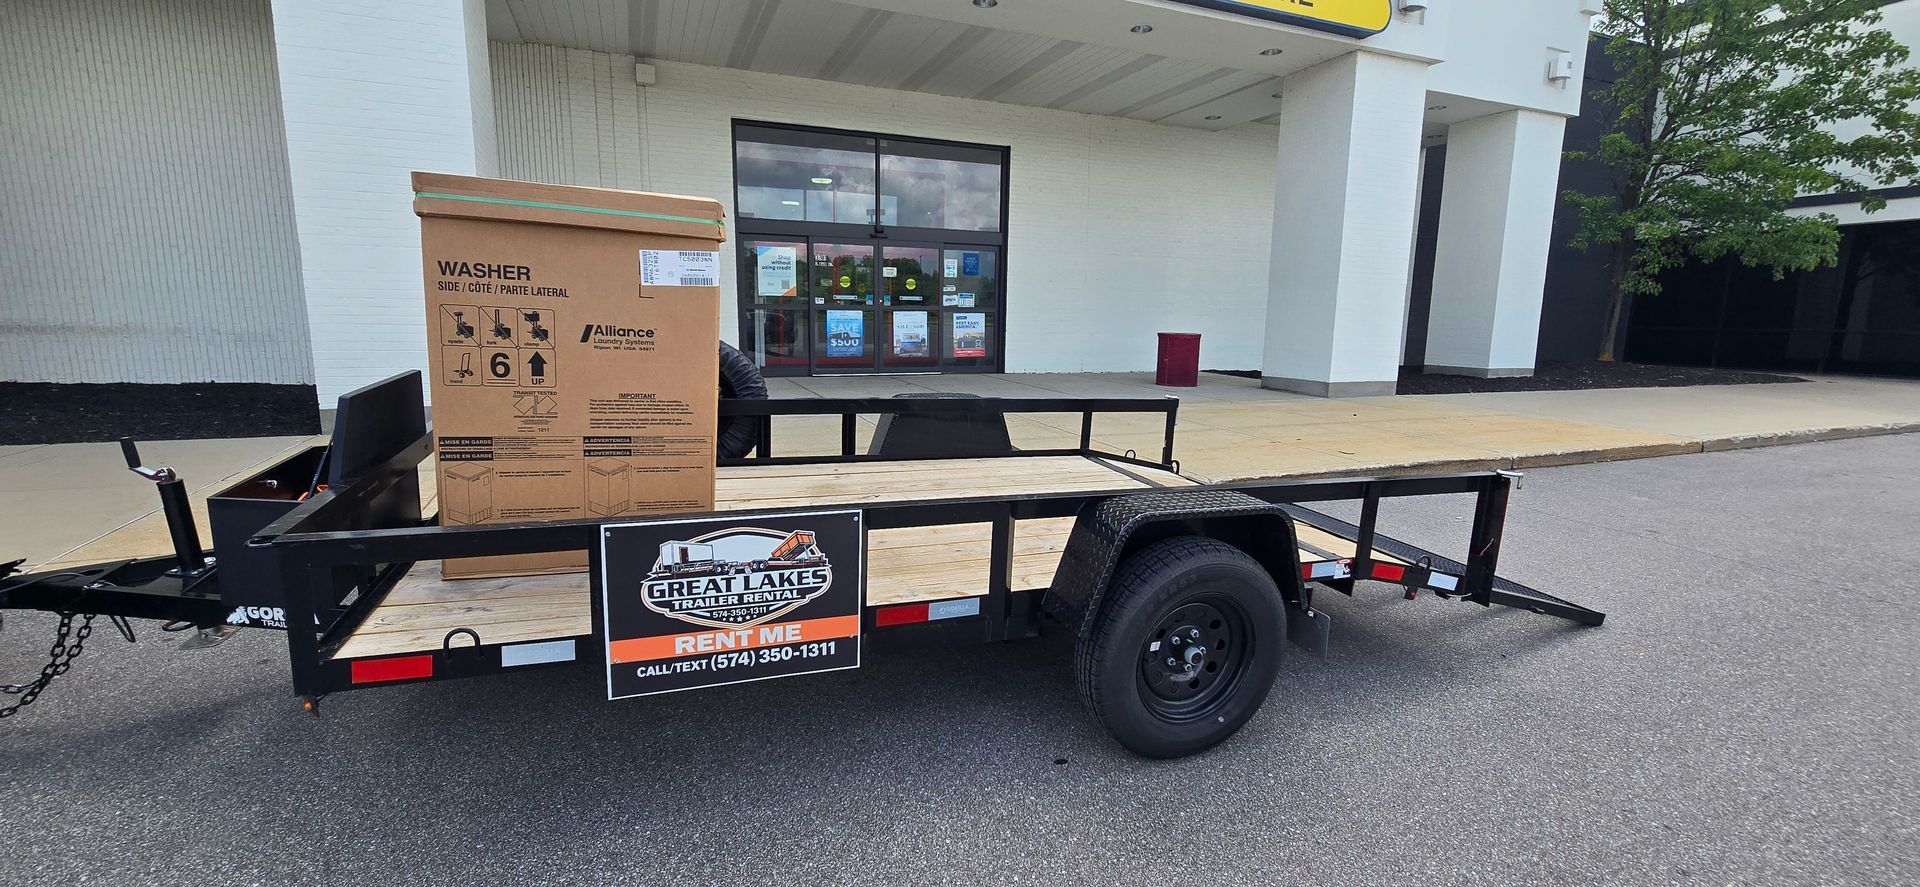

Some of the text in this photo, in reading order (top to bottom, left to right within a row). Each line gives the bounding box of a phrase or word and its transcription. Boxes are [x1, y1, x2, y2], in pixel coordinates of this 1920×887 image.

[437, 260, 531, 281] WASHER
[438, 281, 460, 292] SIDE
[468, 280, 492, 294] CÔTÉ
[500, 284, 529, 296] PARTE
[531, 286, 569, 298] LATERAL
[594, 324, 655, 338] Alliance
[830, 322, 860, 332] SAVE
[593, 337, 655, 346] Laundry Systems
[830, 337, 860, 347] $500
[490, 352, 511, 378] 6
[647, 569, 828, 599] GREAT LAKES
[672, 589, 802, 610] TRAILER RENTAL
[712, 606, 767, 618] 574-350-1311
[674, 623, 802, 655] RENT ME
[636, 641, 836, 678] CALL/TEXT (574) 350-1311
